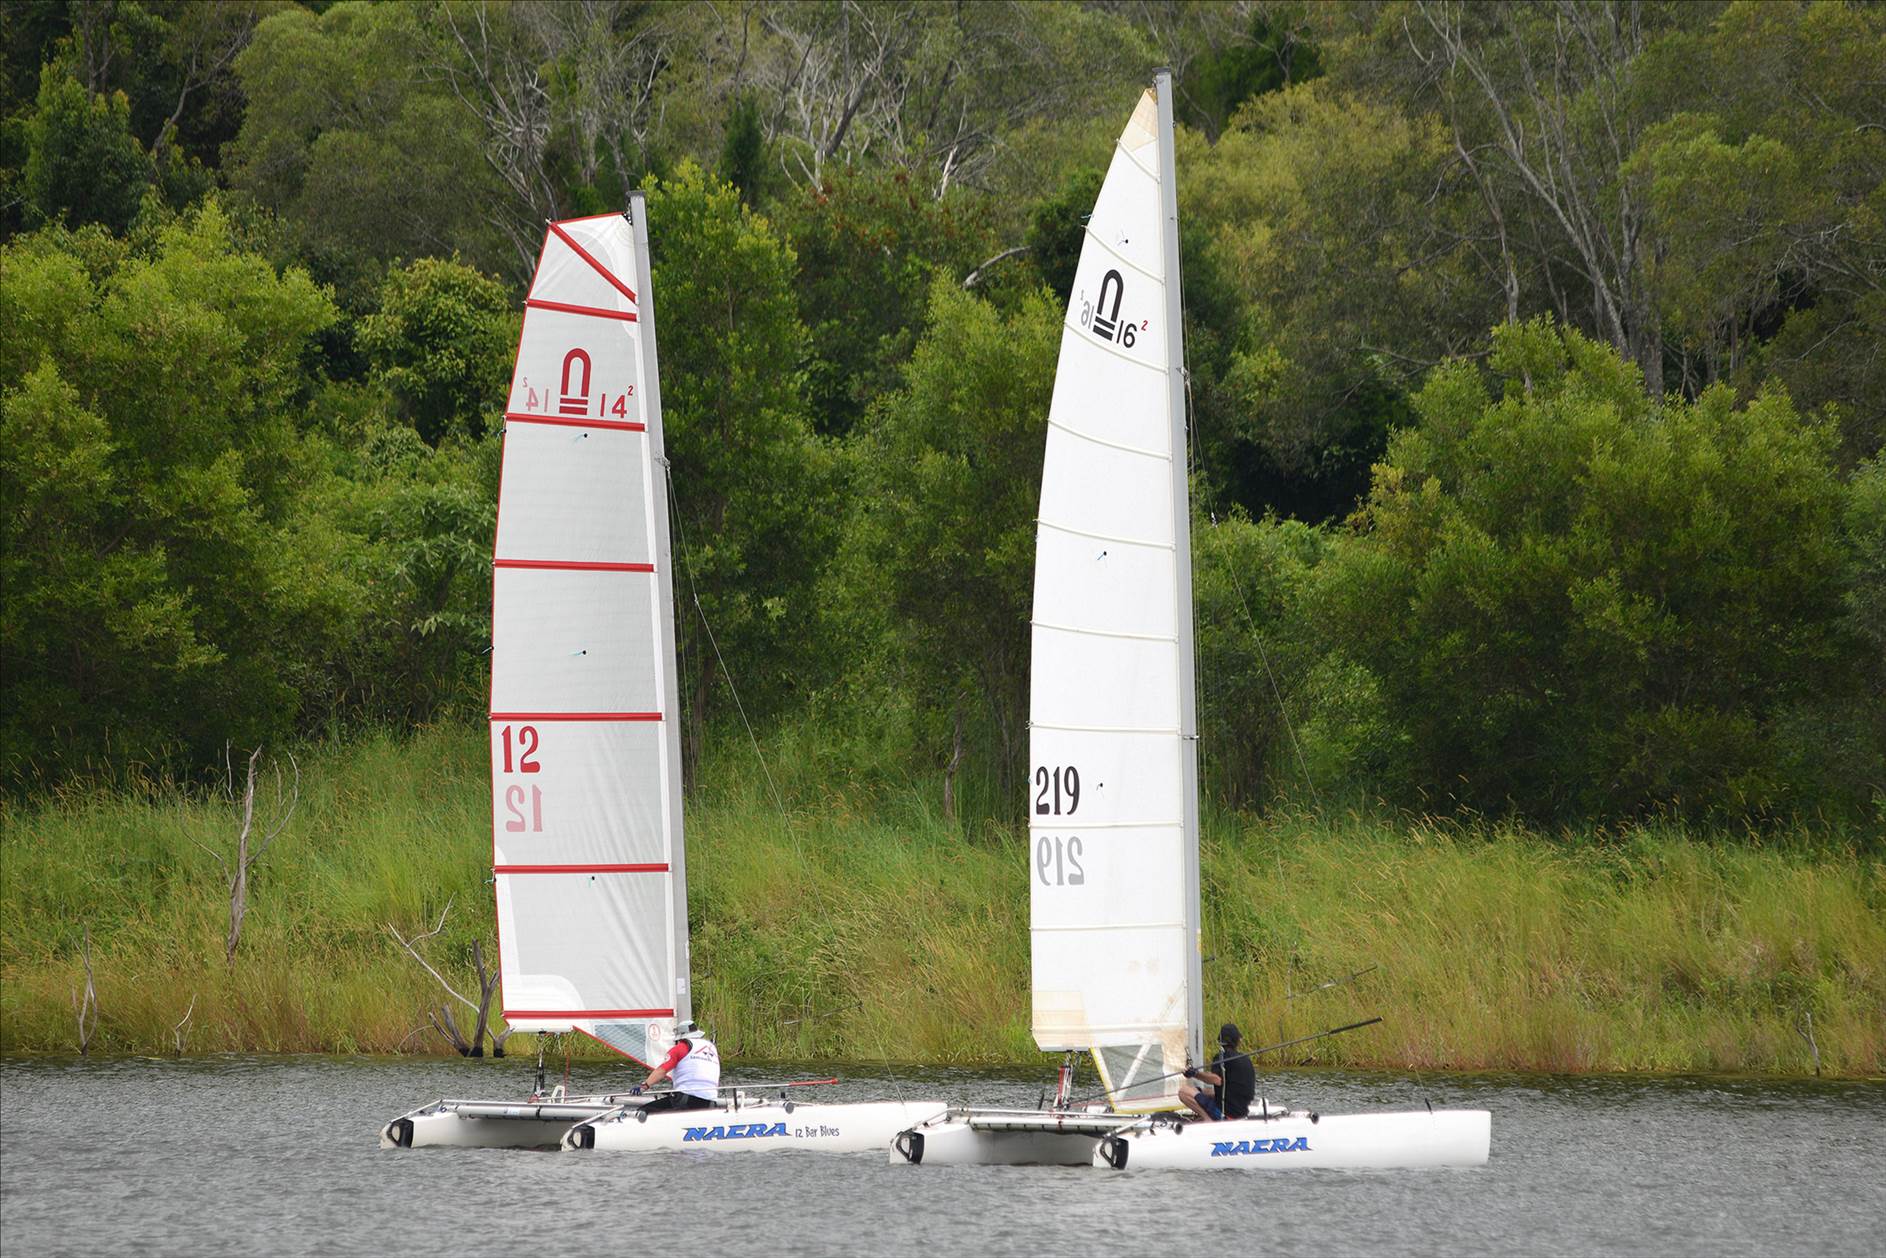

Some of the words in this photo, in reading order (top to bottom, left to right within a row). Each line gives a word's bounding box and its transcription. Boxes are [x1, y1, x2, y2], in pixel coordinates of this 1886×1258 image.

[502, 725, 541, 773] 12
[1035, 766, 1080, 815] 219
[682, 1122, 792, 1142] NACRA
[795, 1128, 803, 1138] 12
[805, 1126, 818, 1138] Bar
[820, 1125, 840, 1137] Blues
[1209, 1137, 1314, 1157] NACRA
